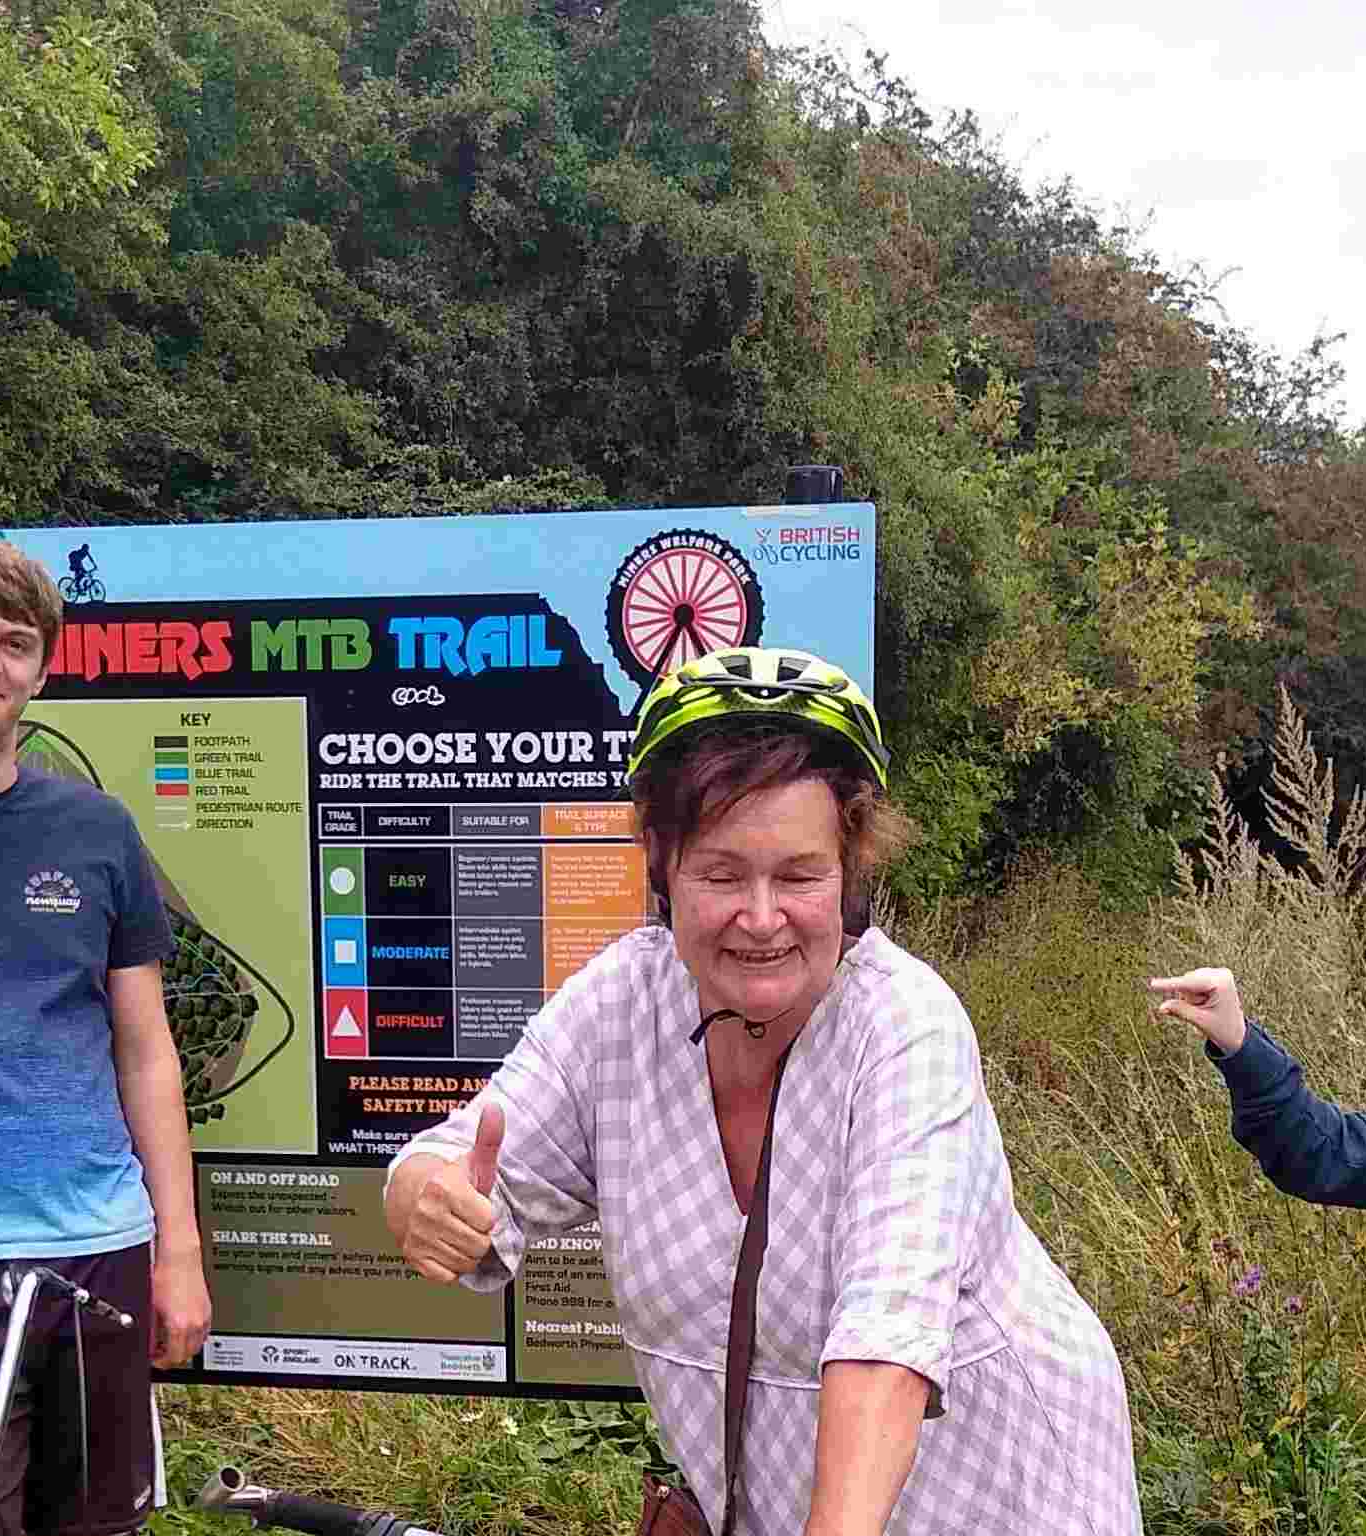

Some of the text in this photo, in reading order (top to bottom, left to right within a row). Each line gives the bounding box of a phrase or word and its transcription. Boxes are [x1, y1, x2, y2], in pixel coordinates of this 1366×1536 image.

[778, 526, 861, 544] BRITISH
[780, 543, 861, 562] CYCLING
[617, 534, 753, 589] MINERS WELFARE PARK
[48, 614, 563, 681] INERS MTB TRAIL
[179, 712, 212, 728] KEY
[194, 735, 252, 747] FOOTPATH
[318, 730, 637, 765] CHOOSE YOUR T
[194, 752, 264, 763] GREEN TRAIL
[194, 767, 256, 779] BLUE TRAIL
[318, 772, 363, 789] RIDE
[364, 772, 403, 788] THE
[404, 772, 461, 789] TRAIL
[463, 772, 514, 788] THAT
[516, 771, 608, 788] MATCHES
[195, 785, 251, 796] RED TRAIL
[196, 802, 304, 813] PEDESTRIAN ROUTE
[196, 818, 254, 829] DIRECTION
[378, 816, 432, 828] DIFFICULTY
[462, 816, 530, 827] SUITABLE FOR
[387, 874, 427, 888] EASY
[26, 896, 82, 910] newquay
[371, 945, 450, 960] MODERATE
[375, 1014, 446, 1030] DIFFICULT
[348, 1075, 410, 1092] PLEASE
[412, 1076, 459, 1092] READ
[363, 1098, 426, 1113] SAFETY
[352, 1129, 409, 1141] Make sure
[329, 1143, 369, 1154] WHAT
[210, 1171, 340, 1188] ON AND OFF ROAD
[211, 1230, 333, 1247] SHARE THE TRAIL
[525, 1255, 547, 1265] Aim
[548, 1255, 560, 1265] to
[562, 1254, 576, 1265] be
[557, 1269, 569, 1280] of
[525, 1281, 551, 1292] First
[525, 1295, 560, 1307] Phone
[524, 1319, 583, 1334] Nearest
[525, 1336, 579, 1349] Bedworth
[333, 1354, 356, 1369] ON
